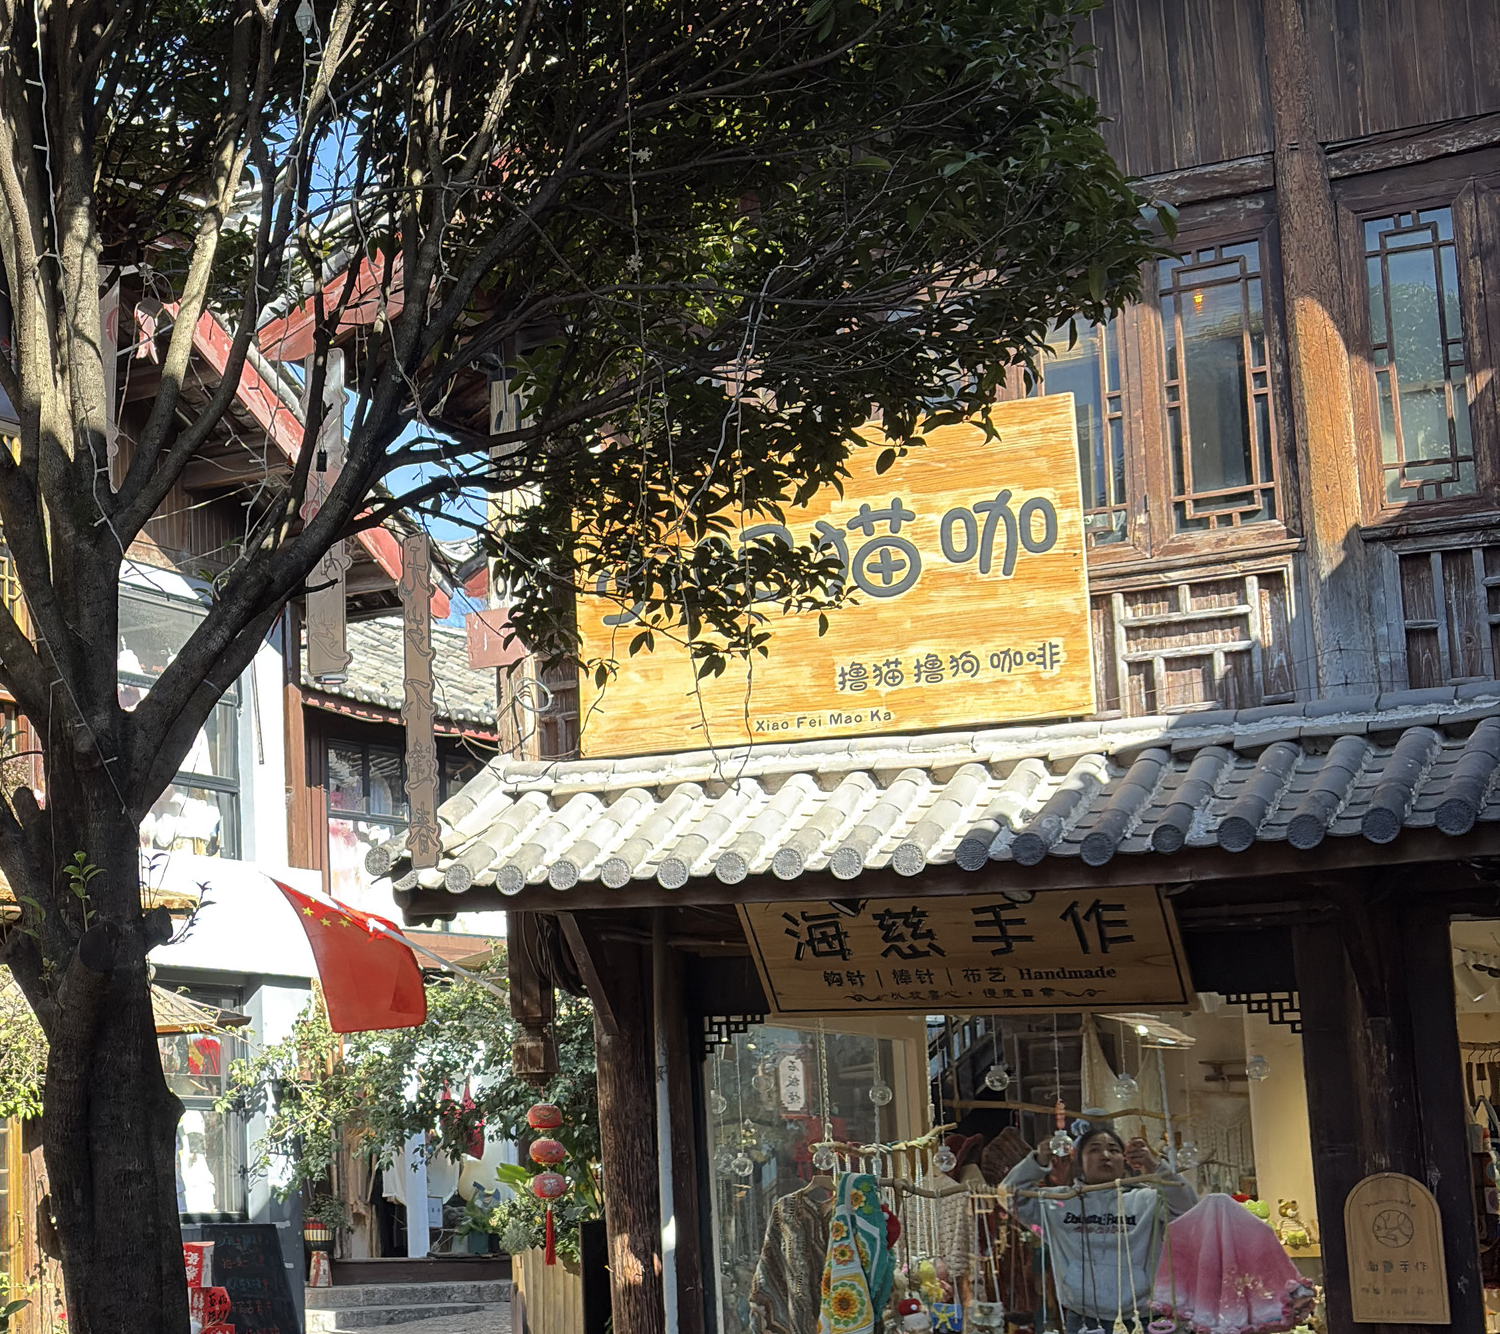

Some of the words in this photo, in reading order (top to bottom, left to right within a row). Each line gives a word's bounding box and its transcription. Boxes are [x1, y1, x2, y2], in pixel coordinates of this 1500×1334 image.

[839, 658, 904, 691] 撸猫
[915, 651, 980, 683] 撸狗
[989, 642, 1060, 673] 咖啡
[756, 718, 789, 732] Xiao
[797, 715, 822, 728] Fei
[829, 712, 862, 725] Mao
[870, 710, 892, 722] Ka
[782, 898, 1136, 961] 海慈手作
[1018, 965, 1117, 981] Handmade
